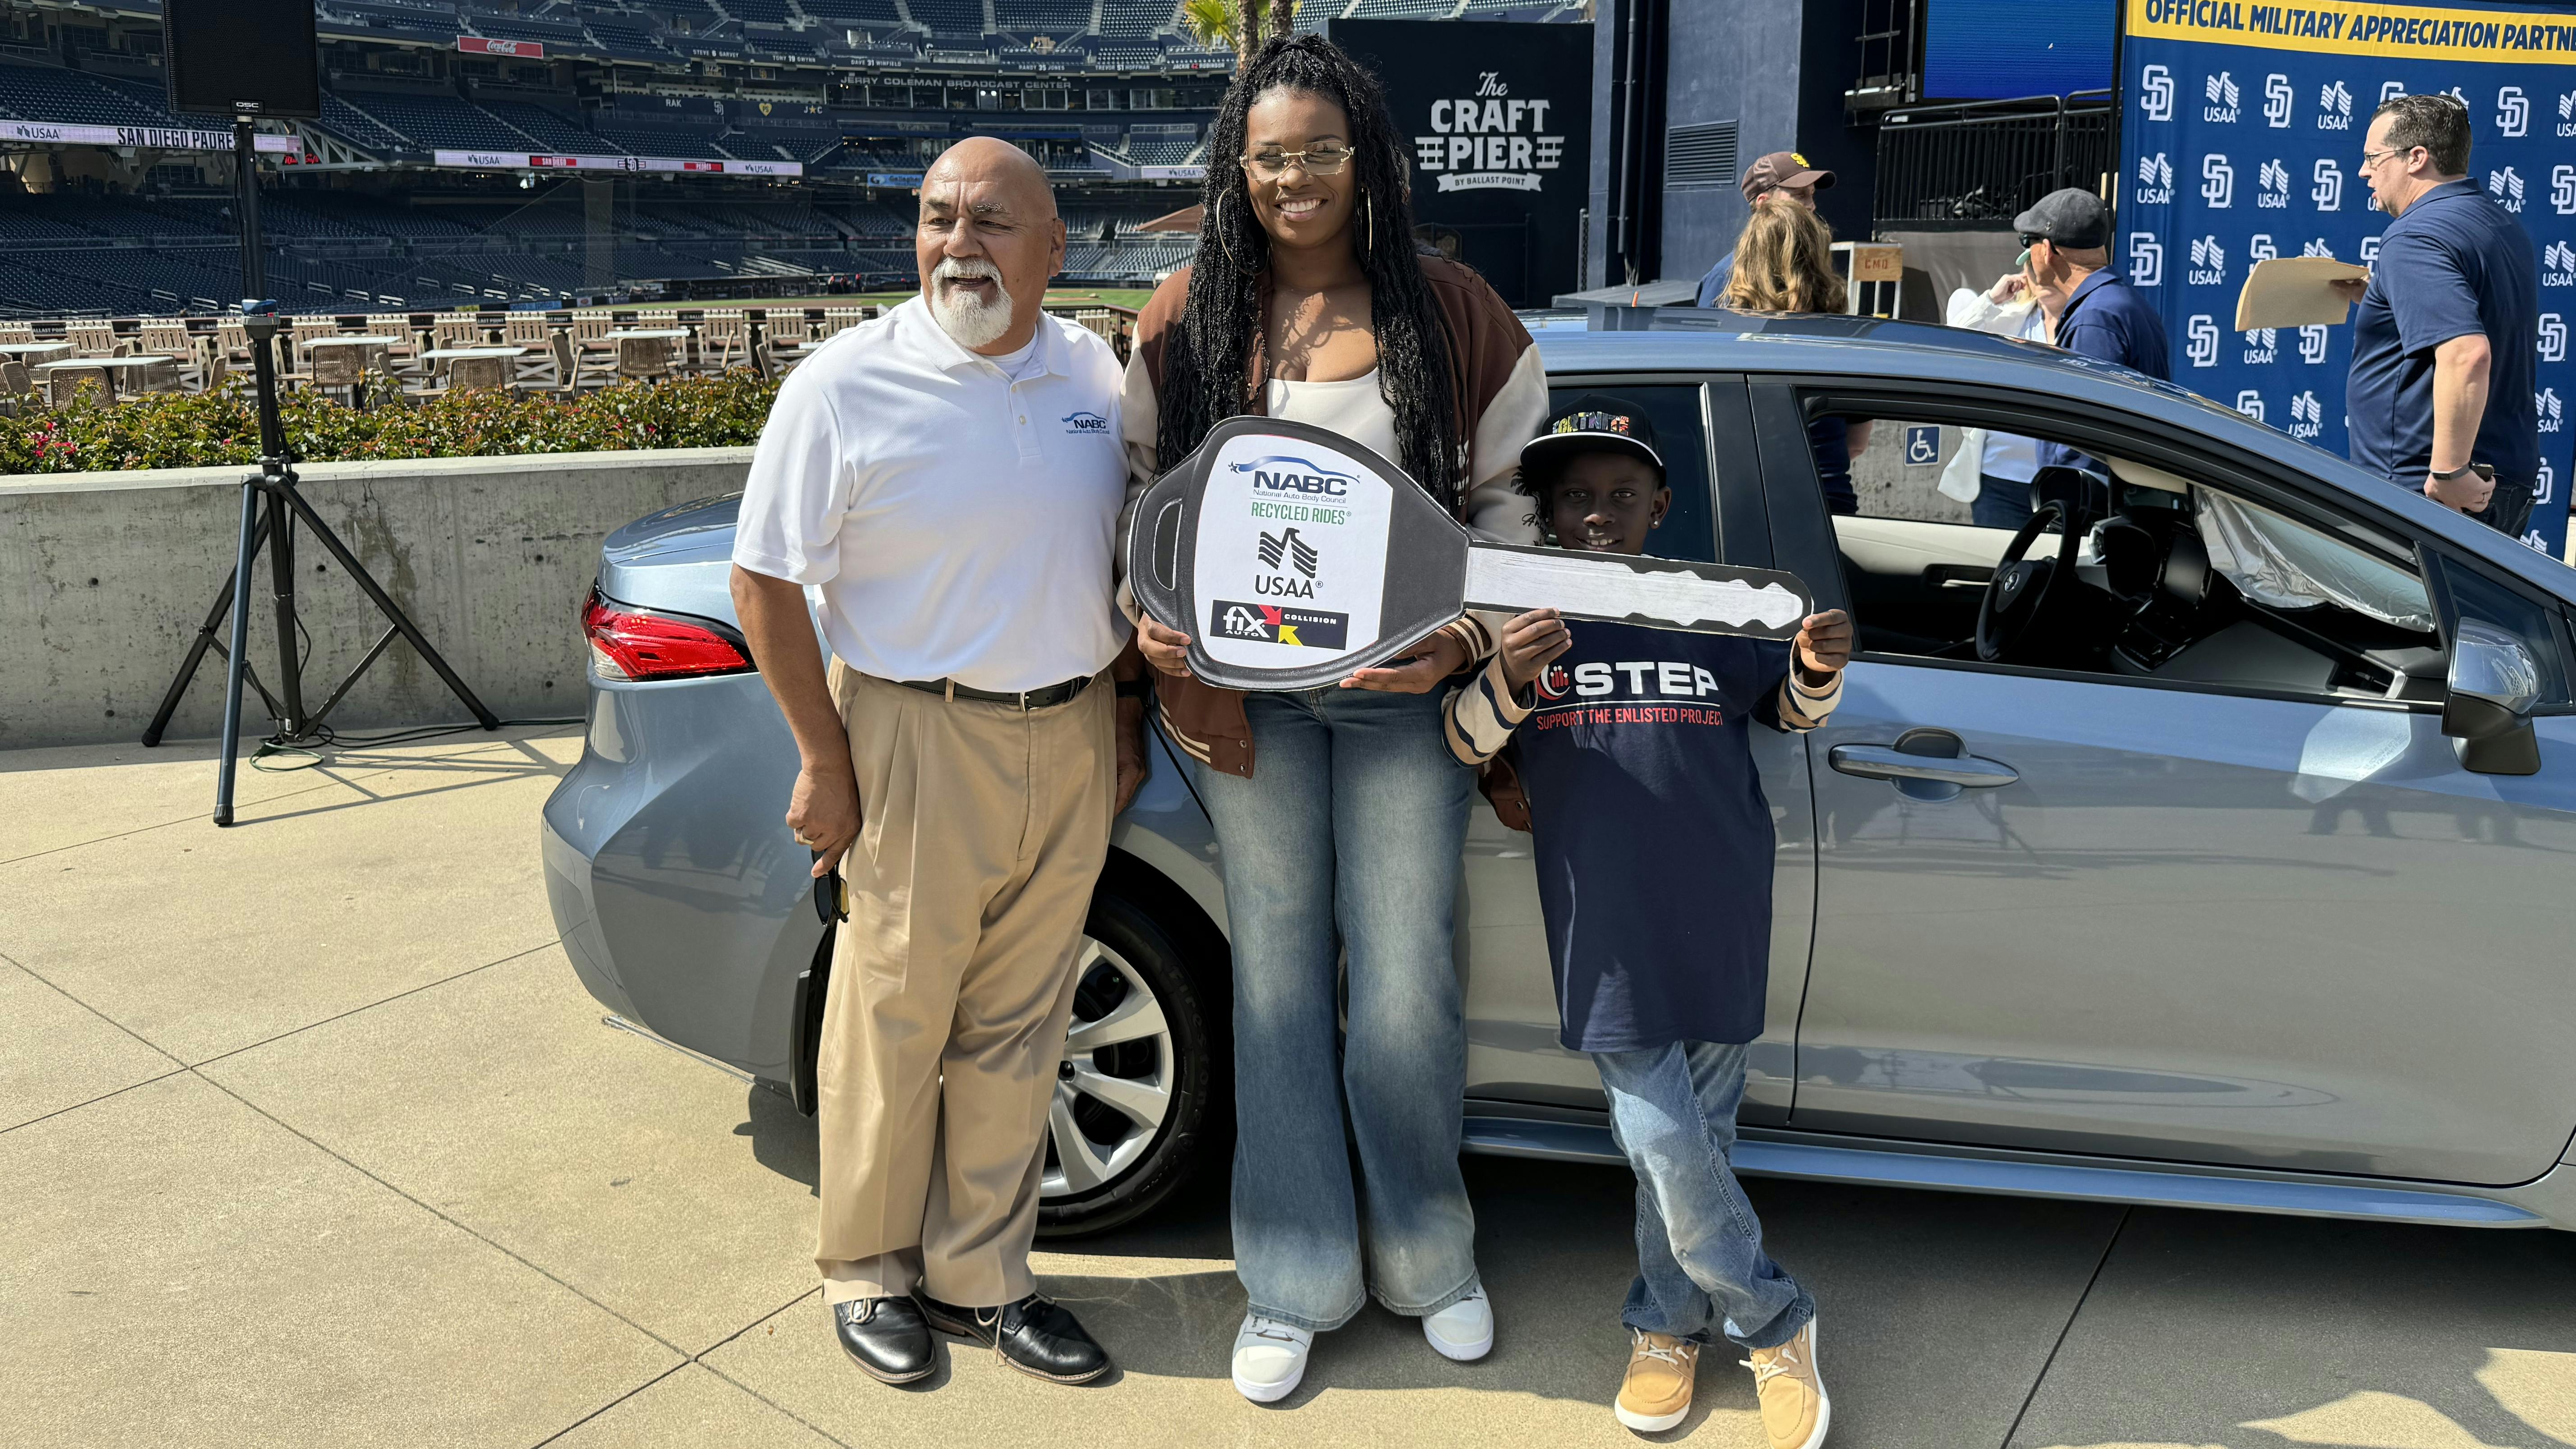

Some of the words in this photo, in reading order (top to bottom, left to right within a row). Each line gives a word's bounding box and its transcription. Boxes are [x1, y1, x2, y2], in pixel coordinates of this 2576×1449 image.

[2146, 0, 2244, 30] OFFICIAL
[2249, 5, 2347, 39] MILITARY
[2347, 14, 2500, 48] APPRECIATION
[841, 77, 878, 85] JERRY
[884, 78, 942, 86] COLEMAN
[947, 79, 1020, 88] BROADCAST
[1476, 71, 1508, 96] The
[666, 99, 681, 108] RAK
[1431, 99, 1550, 133] CRAFT
[31, 128, 60, 139] USAA
[117, 128, 145, 145] SAN
[149, 129, 189, 147] DIEGO
[192, 131, 233, 149] PADRE
[479, 155, 500, 165] USAA
[1448, 136, 1532, 170] PIER
[1467, 176, 1499, 185] BALLAST
[1502, 176, 1525, 186] POINT
[1074, 420, 1106, 428] NABC
[2537, 419, 2559, 432] SAA
[1253, 471, 1347, 496] NABC
[1253, 489, 1282, 498] National
[1302, 494, 1319, 503] Body
[1321, 496, 1346, 504] Council
[1251, 502, 1308, 521] RECYCLED
[1284, 614, 1337, 625] COLLISION
[1574, 662, 1719, 696] STEP
[1536, 711, 1584, 730] SUPPORT
[1586, 708, 1612, 724] THE
[1616, 707, 1677, 723] ENLISTED
